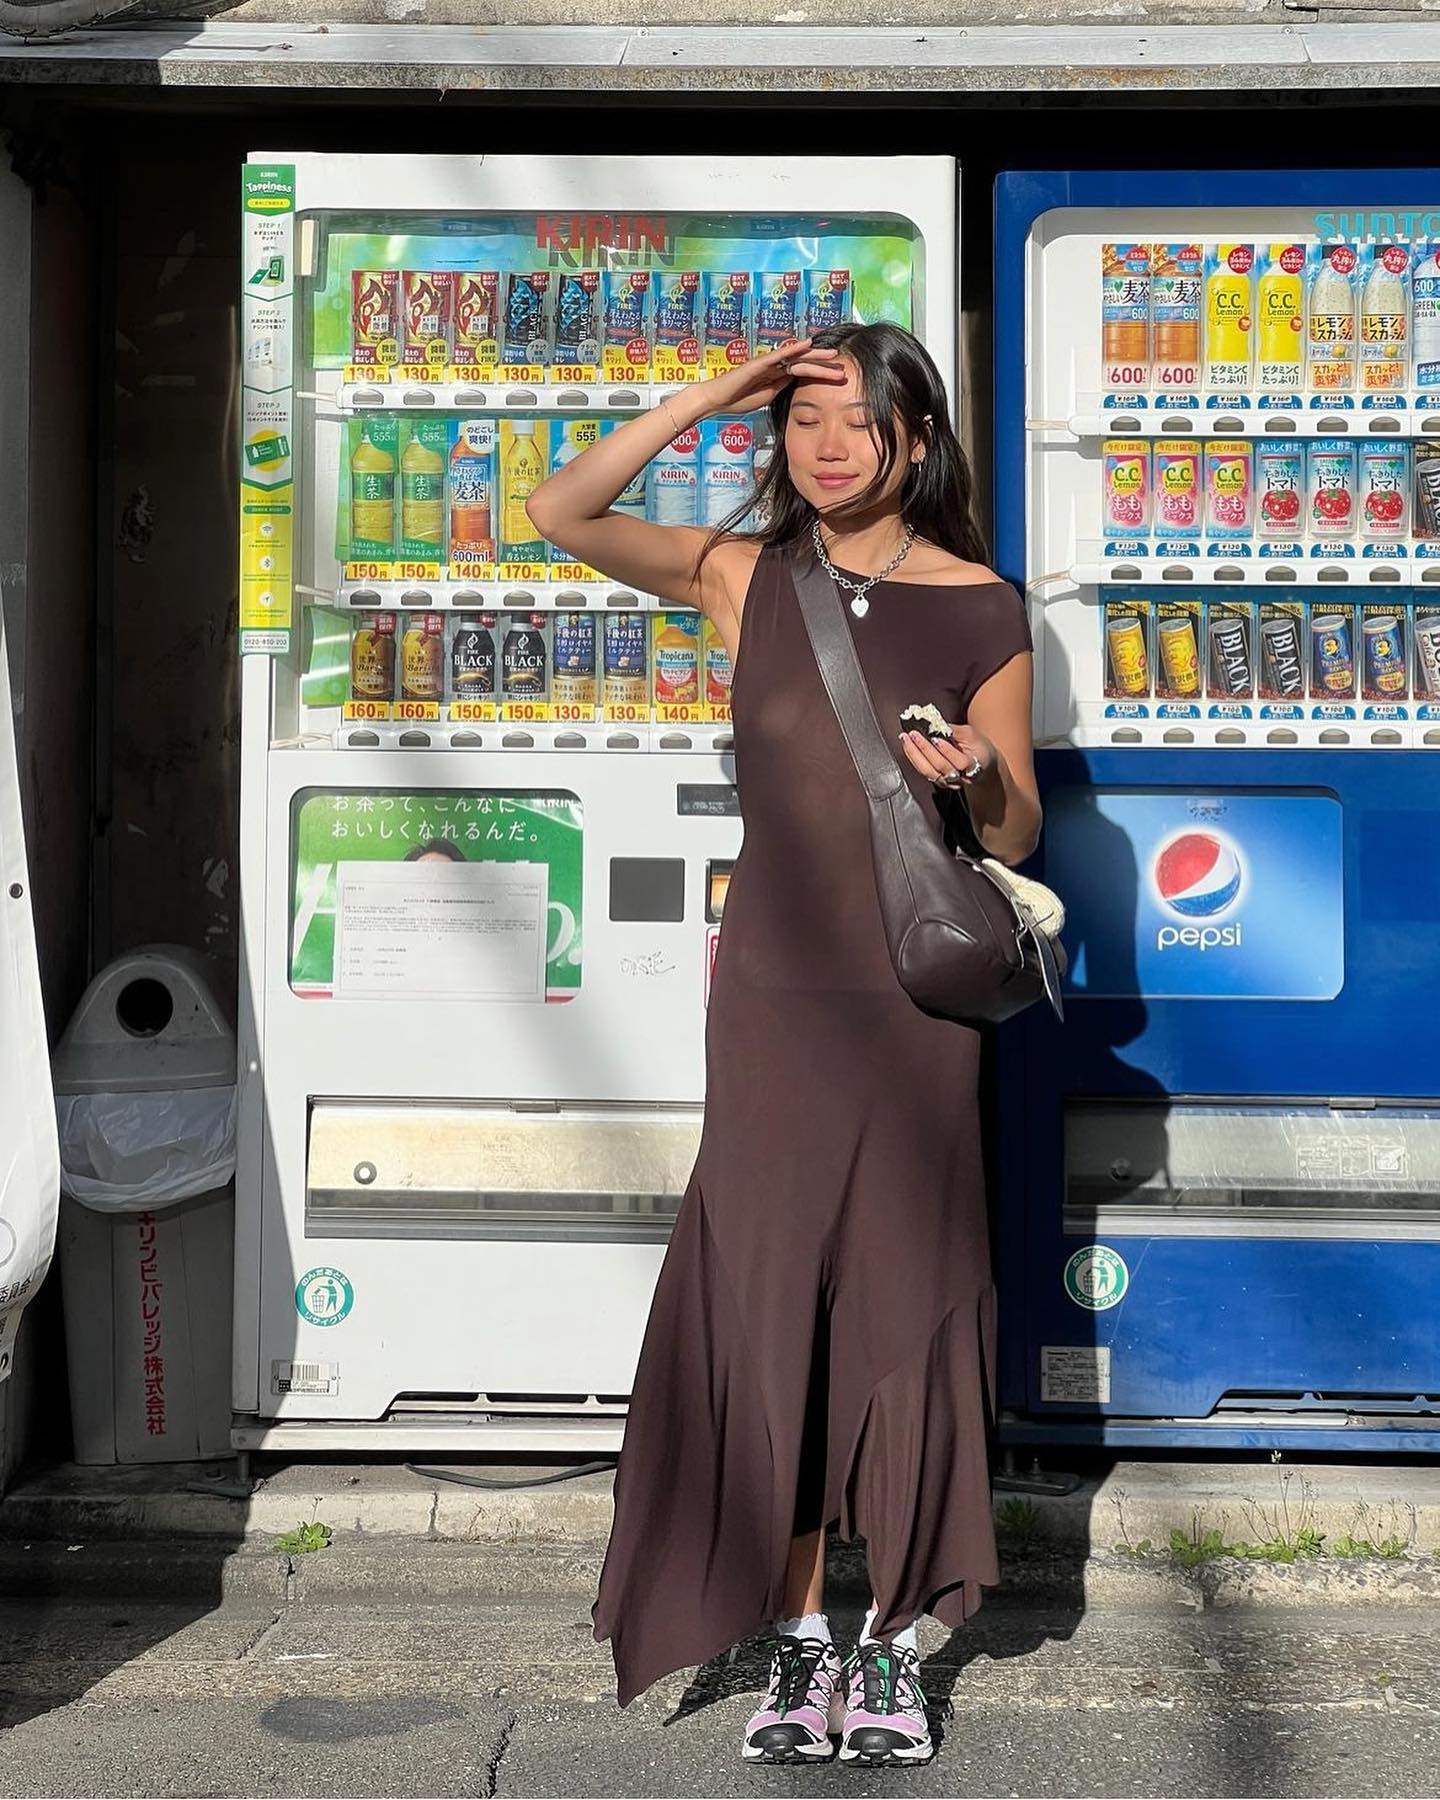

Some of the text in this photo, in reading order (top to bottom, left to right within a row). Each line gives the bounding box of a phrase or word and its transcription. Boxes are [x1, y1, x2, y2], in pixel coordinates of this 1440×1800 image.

[247, 181, 292, 193] Tappiness
[536, 215, 666, 249] KIRIN
[1124, 280, 1150, 304] 麦茶
[1174, 280, 1201, 304] 麦茶
[1415, 279, 1434, 292] 600
[1216, 294, 1244, 309] C.C.
[1269, 294, 1296, 309] C.C.
[1216, 308, 1243, 316] Lemon
[1268, 308, 1295, 316] Lemon
[528, 307, 538, 340] BLACK
[579, 307, 589, 340] BLACK
[1317, 317, 1347, 328] レモン
[1369, 317, 1399, 328] レモン
[1317, 329, 1353, 340] スカッシュ
[1369, 329, 1405, 340] スカッシュ
[350, 367, 385, 381] 130円
[404, 367, 439, 381] 130円
[455, 367, 489, 381] 130円
[504, 367, 539, 381] 130円
[556, 367, 591, 381] 130円
[609, 367, 644, 381] 130円
[659, 367, 695, 381] 130円
[1111, 367, 1144, 383] 600
[1162, 367, 1195, 383] 600
[1210, 365, 1248, 374] ビタミンC
[1262, 365, 1299, 374] ビタミンC
[1313, 363, 1348, 373] スカッと!
[1365, 363, 1400, 373] スカッと!
[1210, 375, 1247, 385] たっぷり!
[1262, 375, 1299, 385] たっぷり!
[373, 432, 391, 442] 555
[422, 432, 440, 442] 555
[467, 426, 494, 434] のどごし
[576, 431, 596, 441] 555
[468, 435, 491, 445] 爽快!
[723, 436, 744, 445] 600
[660, 470, 689, 479] KIRIN
[712, 470, 741, 479] KIRIN
[1114, 467, 1142, 482] C.C.
[1166, 467, 1193, 482] C.C.
[1217, 467, 1245, 482] C.C.
[1264, 470, 1299, 478] すっきりした
[1315, 468, 1350, 477] すっきりした
[1368, 470, 1402, 479] すっきりした
[366, 475, 380, 499] 生茶
[415, 475, 429, 499] 生茶
[1266, 478, 1297, 490] トマト
[1318, 476, 1349, 488] トマト
[1370, 478, 1401, 490] トマト
[455, 482, 485, 501] 麦茶
[1113, 495, 1141, 511] もも
[1165, 495, 1192, 511] もも
[1216, 495, 1244, 511] もも
[1113, 511, 1142, 521] ミックス
[1165, 511, 1193, 521] ミックス
[1216, 511, 1245, 521] ミックス
[352, 564, 387, 579] 150円
[400, 564, 435, 579] 150円
[455, 564, 491, 579] 140円
[505, 564, 540, 579] 170円
[557, 564, 592, 579] 150円
[454, 655, 493, 667] BLACK
[505, 655, 543, 667] BLACK
[659, 650, 694, 662] Tropicana
[1220, 632, 1251, 693] BLACK
[1272, 632, 1302, 696] BLACK
[350, 703, 385, 718] 160円
[399, 703, 435, 718] 160円
[457, 704, 491, 719] 150円
[508, 704, 544, 719] 150円
[554, 704, 590, 719] 130円
[609, 705, 645, 720] 130円
[663, 706, 698, 720] 140円
[333, 797, 516, 813] お茶って、こんなに
[331, 820, 538, 842] おいしくなれるんだ。
[1158, 923, 1242, 952] pepsi
[1076, 1292, 1118, 1307] リサイクル
[137, 1210, 167, 1437] キリンビバレッジ株式会社
[304, 1311, 346, 1326] リサイクル
